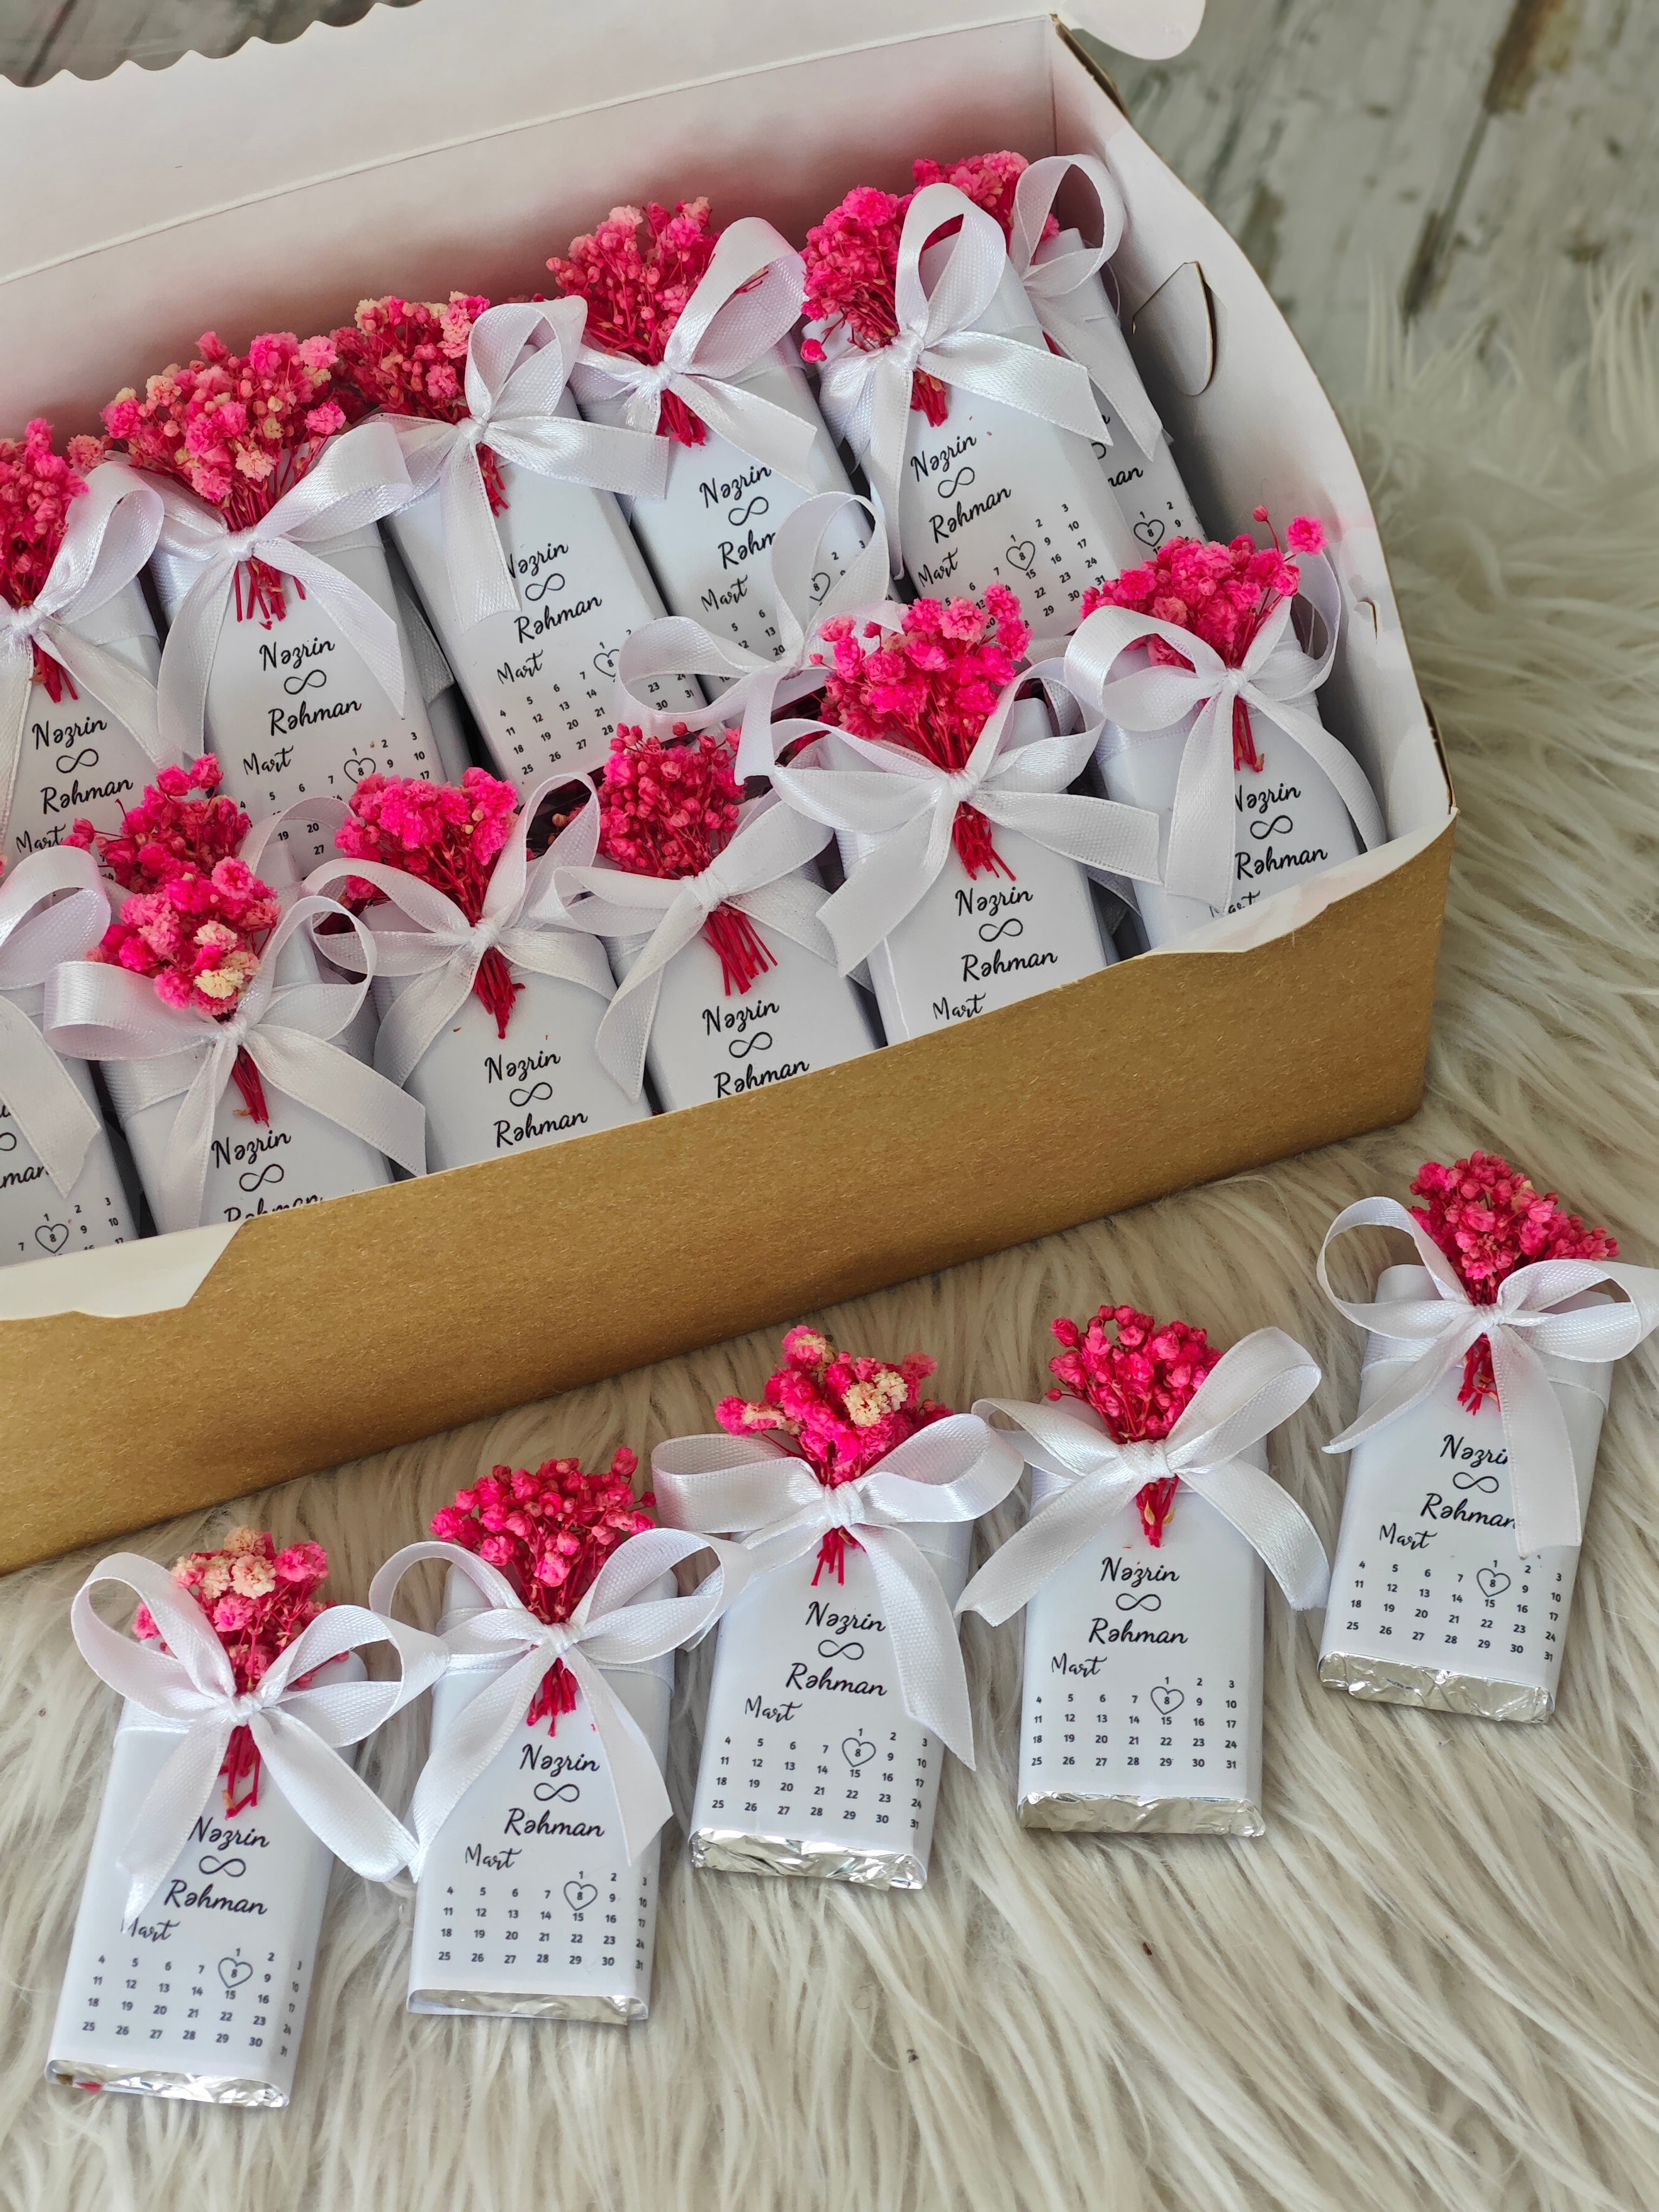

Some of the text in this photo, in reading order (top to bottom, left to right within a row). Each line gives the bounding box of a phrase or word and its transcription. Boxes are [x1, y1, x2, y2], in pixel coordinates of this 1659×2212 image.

[910, 435, 977, 482] Nəzrin
[699, 466, 771, 509] Nəzrin
[929, 488, 1011, 544] Rəhman
[1010, 503, 1069, 543] 1 2 3
[718, 529, 776, 570] Rəhm
[831, 551, 840, 561] 2
[944, 520, 1079, 607] 5 6 7 8 9 10
[1025, 538, 1087, 580] 15 16 17
[918, 547, 958, 587] Mart
[1034, 556, 1098, 599] 22 23 24
[701, 574, 748, 612] Mart
[513, 597, 602, 644] Rəhman
[731, 609, 766, 632] 5 6
[764, 626, 776, 638] 13
[259, 637, 335, 671] Nəzrin
[599, 641, 605, 650] 1
[497, 649, 543, 684] Mart
[500, 659, 614, 717] 4 5 6 7 8
[268, 700, 362, 736] Rəhman
[505, 689, 597, 736] 11 12 13 14
[32, 716, 107, 750] Nəzrin
[351, 731, 417, 756] 1 2 3
[513, 706, 606, 755] 18 19 20 21
[243, 745, 294, 775] Mart
[420, 770, 429, 780] 17
[240, 750, 426, 809] 4 5 6 7 8 9 10
[40, 780, 133, 815] Rəhman
[16, 824, 66, 853] Mart
[277, 822, 319, 841] 19 20
[1234, 846, 1328, 880] Rəhman
[955, 886, 1033, 916] Nəzrin
[961, 948, 1058, 982] Rəhman
[702, 1000, 780, 1036] Nəzrin
[933, 993, 986, 1020] Mart
[485, 1050, 561, 1084] Nəzrin
[713, 1061, 809, 1098] Rəhman
[493, 1113, 588, 1148] Rəhman
[211, 1130, 291, 1169] Nəzrin
[43, 1197, 111, 1222] 1 2 3
[17, 1217, 119, 1251] 7 8 9 10
[1440, 1434, 1508, 1468] Nəzri
[1379, 1522, 1437, 1550] Mart
[1100, 1557, 1180, 1588] Nəzrin
[1358, 1560, 1561, 1603] 4 5 6 7 8 9 10
[1493, 1559, 1562, 1582] 1 2 3
[805, 1602, 886, 1635] Nəzrin
[1088, 1617, 1188, 1644] Rəhman
[786, 1662, 888, 1696] Rəhman
[1051, 1652, 1107, 1677] Mart
[1164, 1676, 1235, 1689] 1 2 3
[745, 1695, 802, 1722] Mart
[1036, 1693, 1237, 1709] 4 5 6 7 8 9 10
[858, 1727, 928, 1747] 1 2 3
[1034, 1713, 1237, 1729] 11 12 13 14 15 16 17
[519, 1743, 600, 1777] Nəzrin
[724, 1736, 927, 1769] 4 5 6 7 8 9 10
[187, 1814, 269, 1851] Nəzrin
[504, 1808, 605, 1837] Rəhman
[465, 1843, 522, 1870] Mart
[578, 1870, 647, 1887] 1 2 3
[164, 1879, 268, 1915] Rəhman
[446, 1886, 647, 1908] 4 5 6 7 8 9 10
[98, 1954, 106, 1964] 4
[131, 1957, 139, 1968] 5
[164, 1961, 172, 1971] 6
[198, 1964, 205, 1975] 7
[230, 1968, 238, 1979] 8
[263, 1973, 272, 1983] 9
[235, 1947, 241, 1957] 1
[267, 1952, 275, 1962] 2
